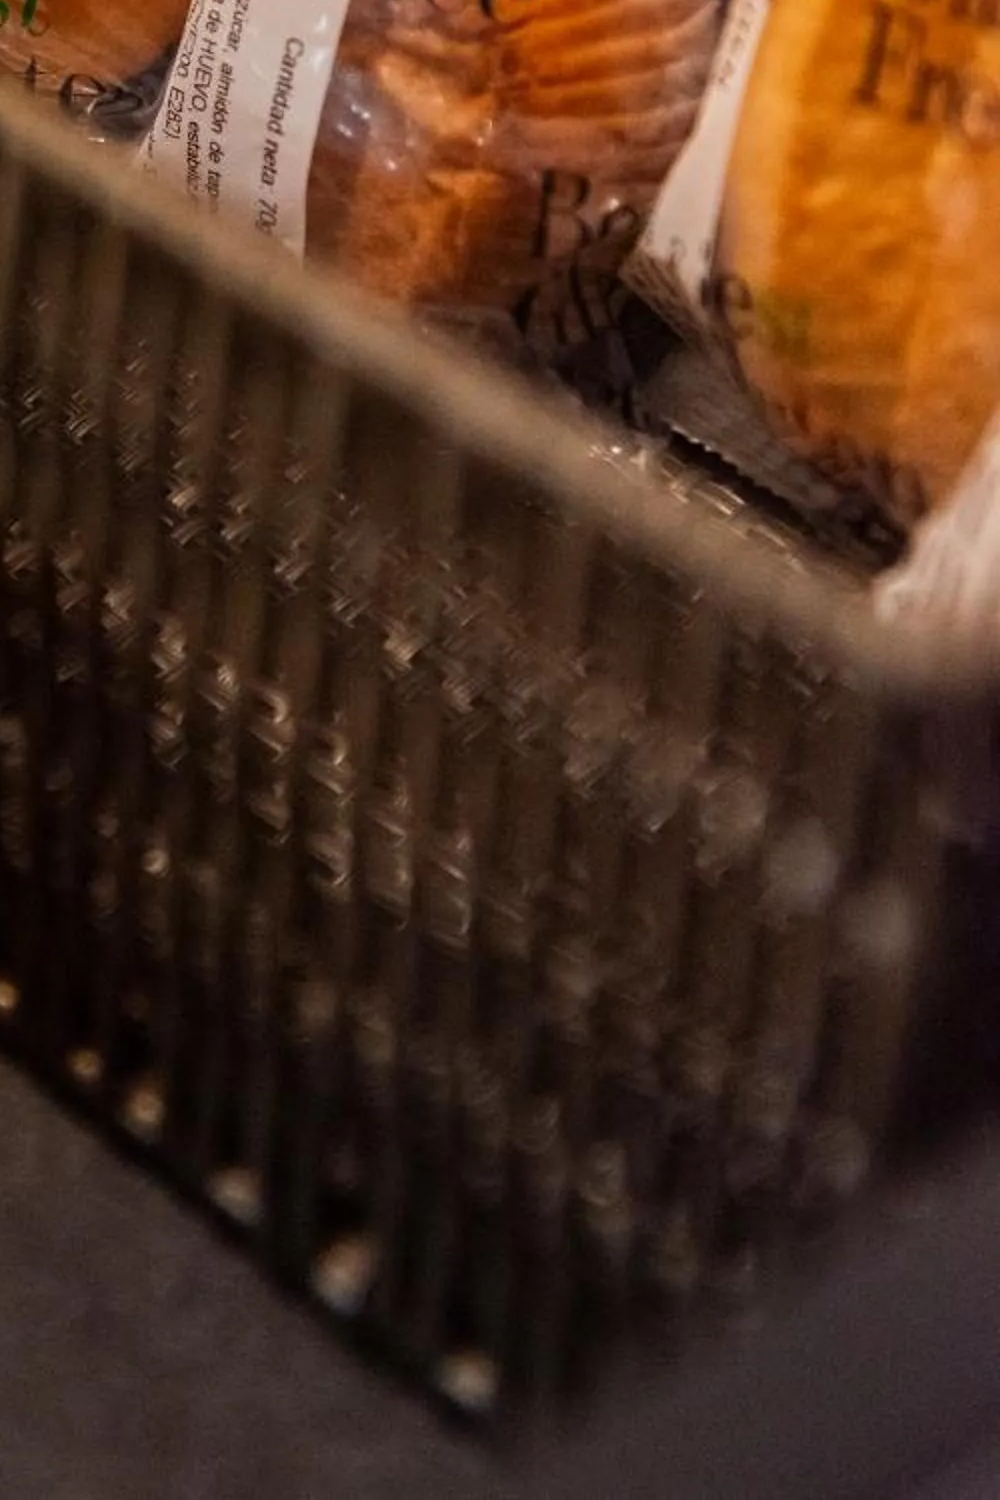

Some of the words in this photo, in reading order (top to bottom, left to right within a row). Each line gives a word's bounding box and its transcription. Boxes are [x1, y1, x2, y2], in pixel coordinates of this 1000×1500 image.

[204, 8, 224, 35] de
[209, 62, 236, 135] almidón
[265, 36, 306, 135] Cantidad
[206, 140, 227, 164] de
